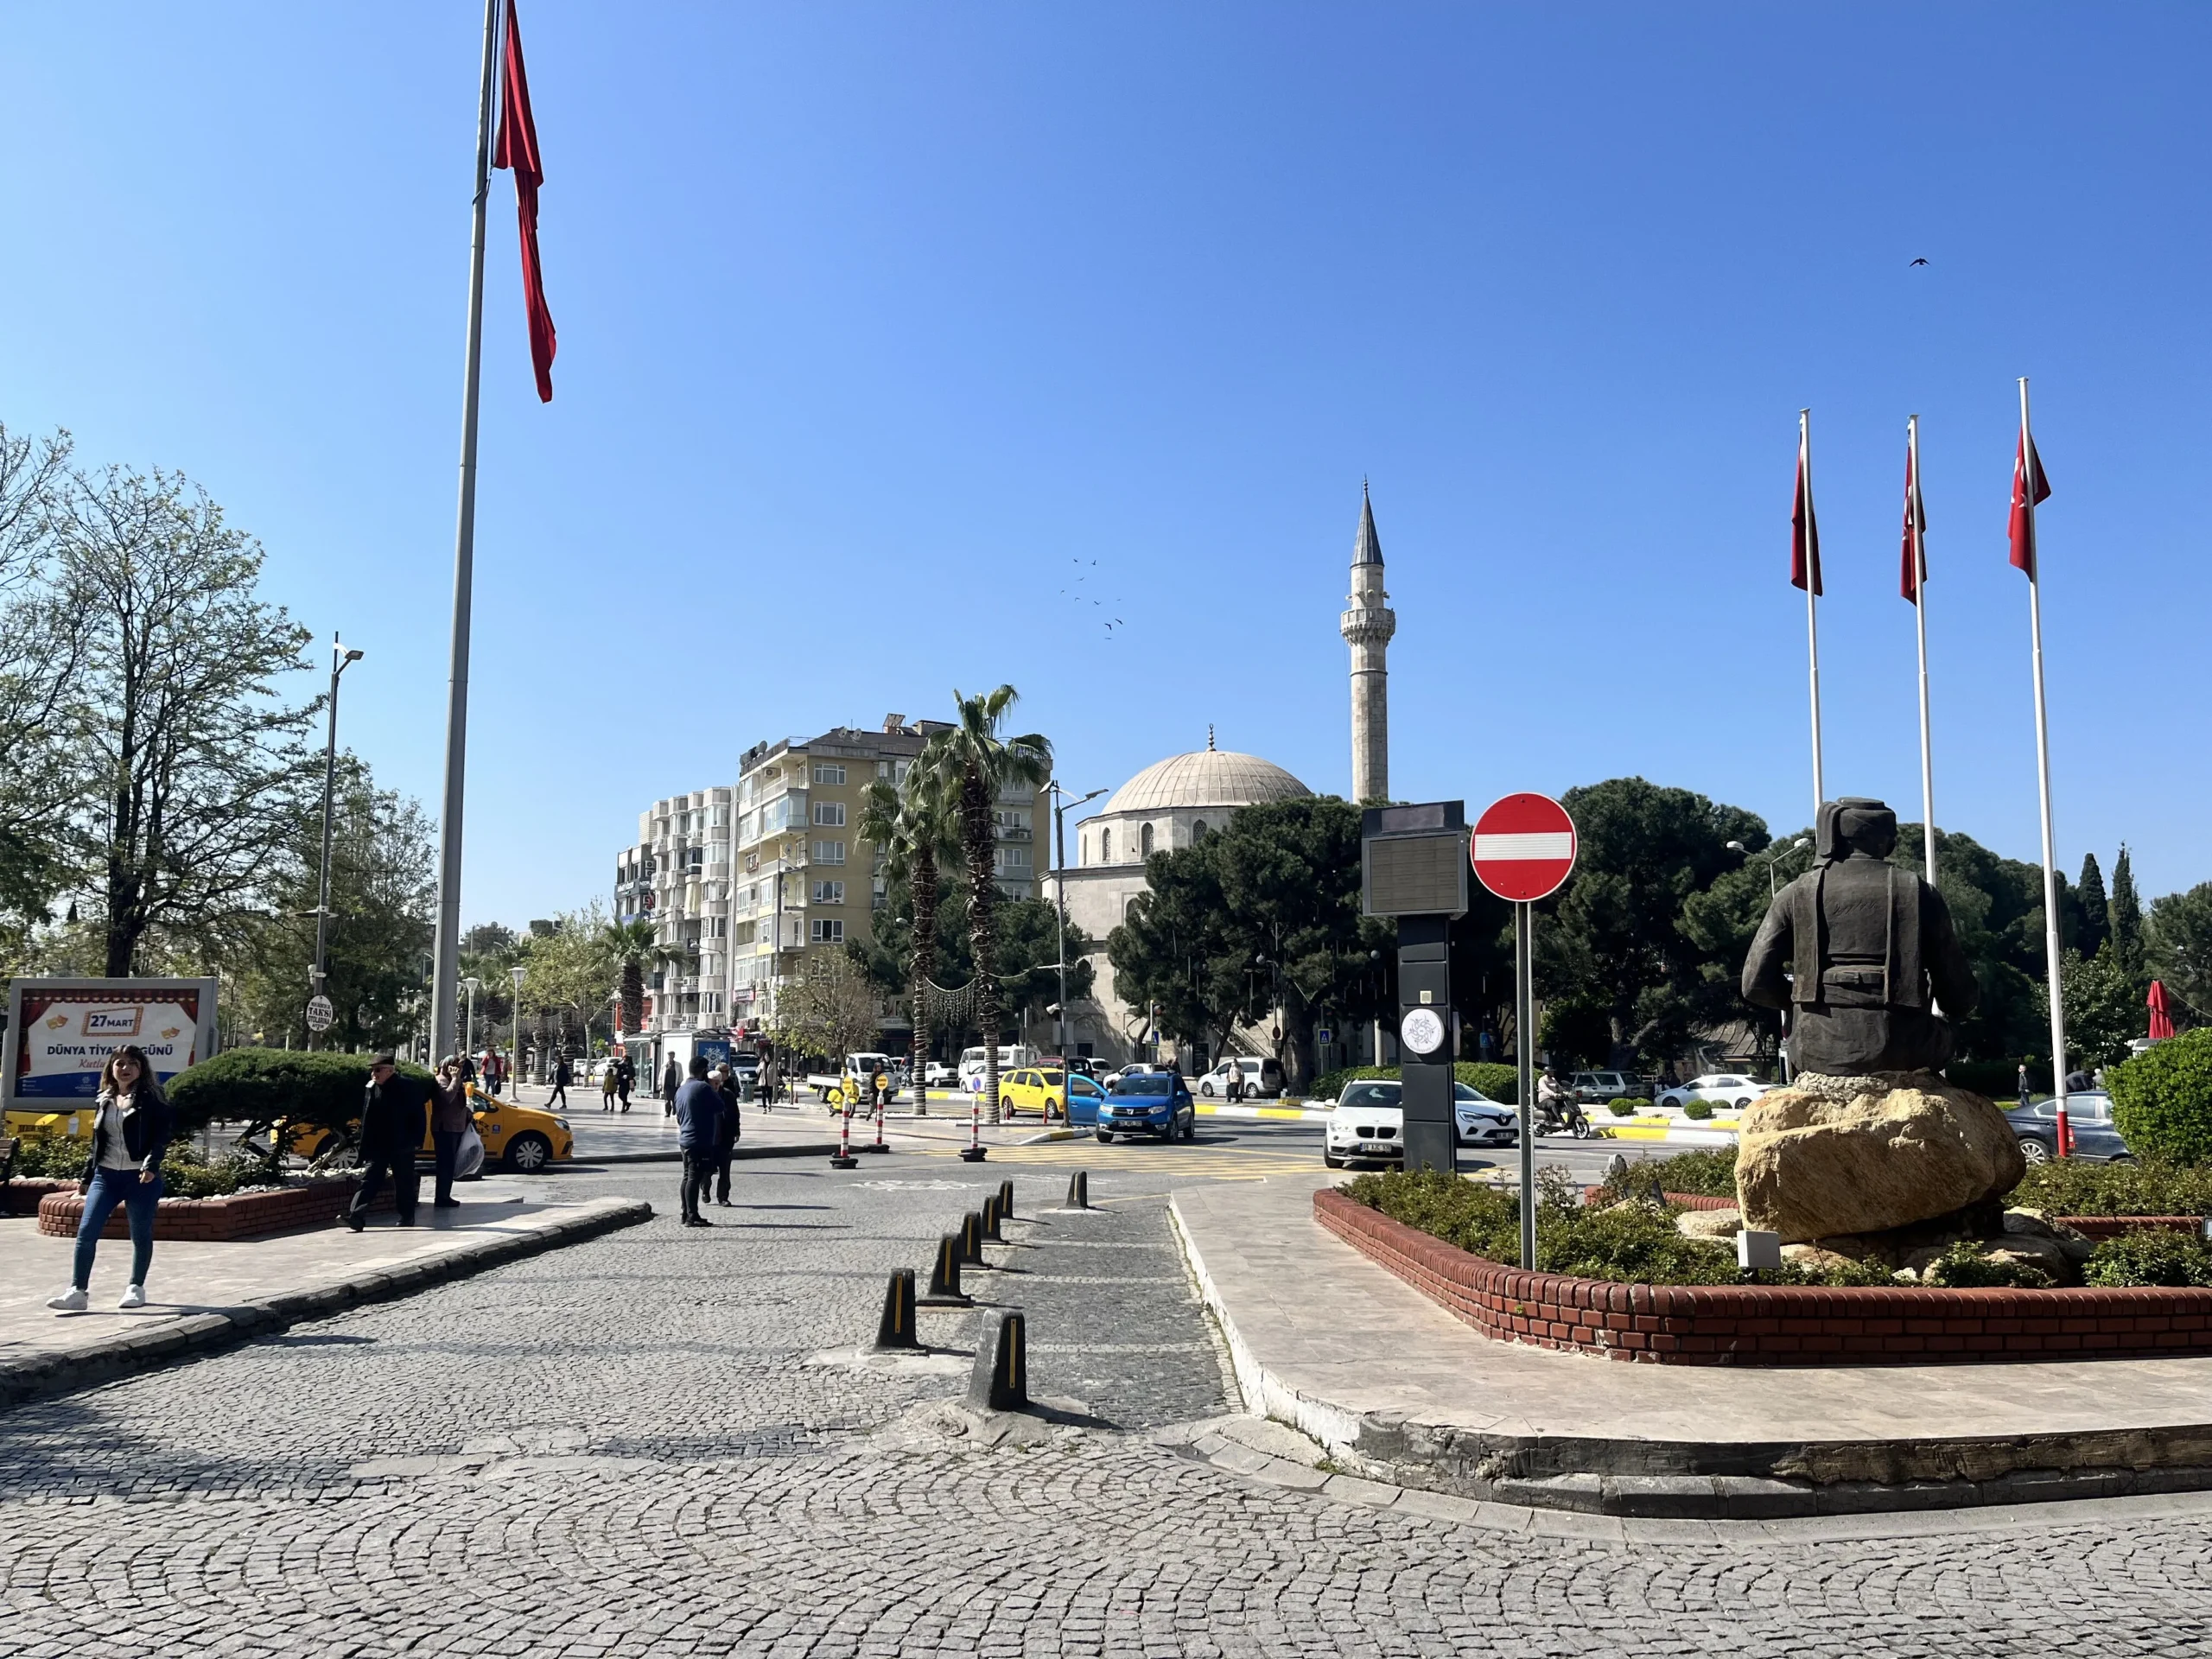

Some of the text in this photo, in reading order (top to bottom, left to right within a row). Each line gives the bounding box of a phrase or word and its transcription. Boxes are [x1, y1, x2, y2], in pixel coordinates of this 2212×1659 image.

[90, 1015, 134, 1027] 27 MART
[48, 1044, 86, 1055] DÜNYA
[89, 1044, 118, 1055] TİYA
